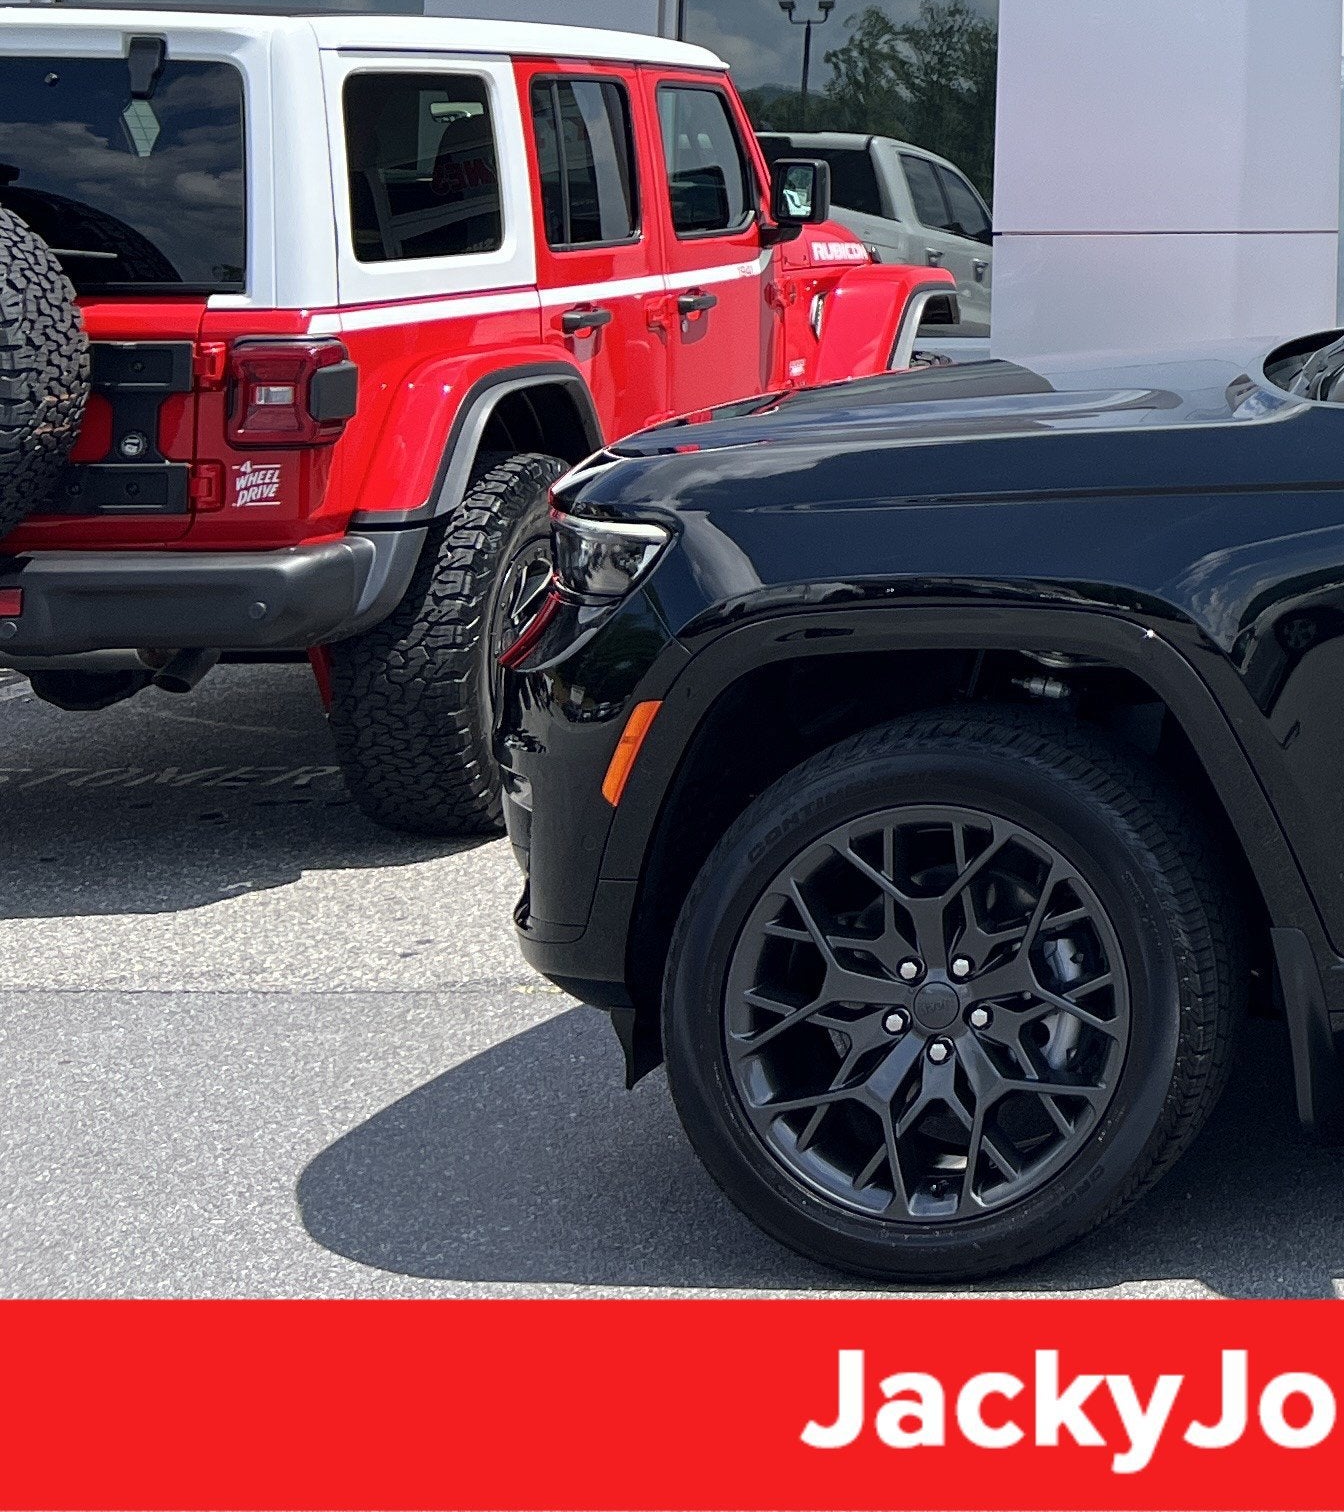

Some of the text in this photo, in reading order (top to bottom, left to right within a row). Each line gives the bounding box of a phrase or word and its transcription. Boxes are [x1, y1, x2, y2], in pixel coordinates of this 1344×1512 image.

[811, 241, 869, 261] RUBICON
[240, 460, 253, 474] 4
[236, 470, 280, 491] WHEEL
[236, 484, 280, 507] DRIVE
